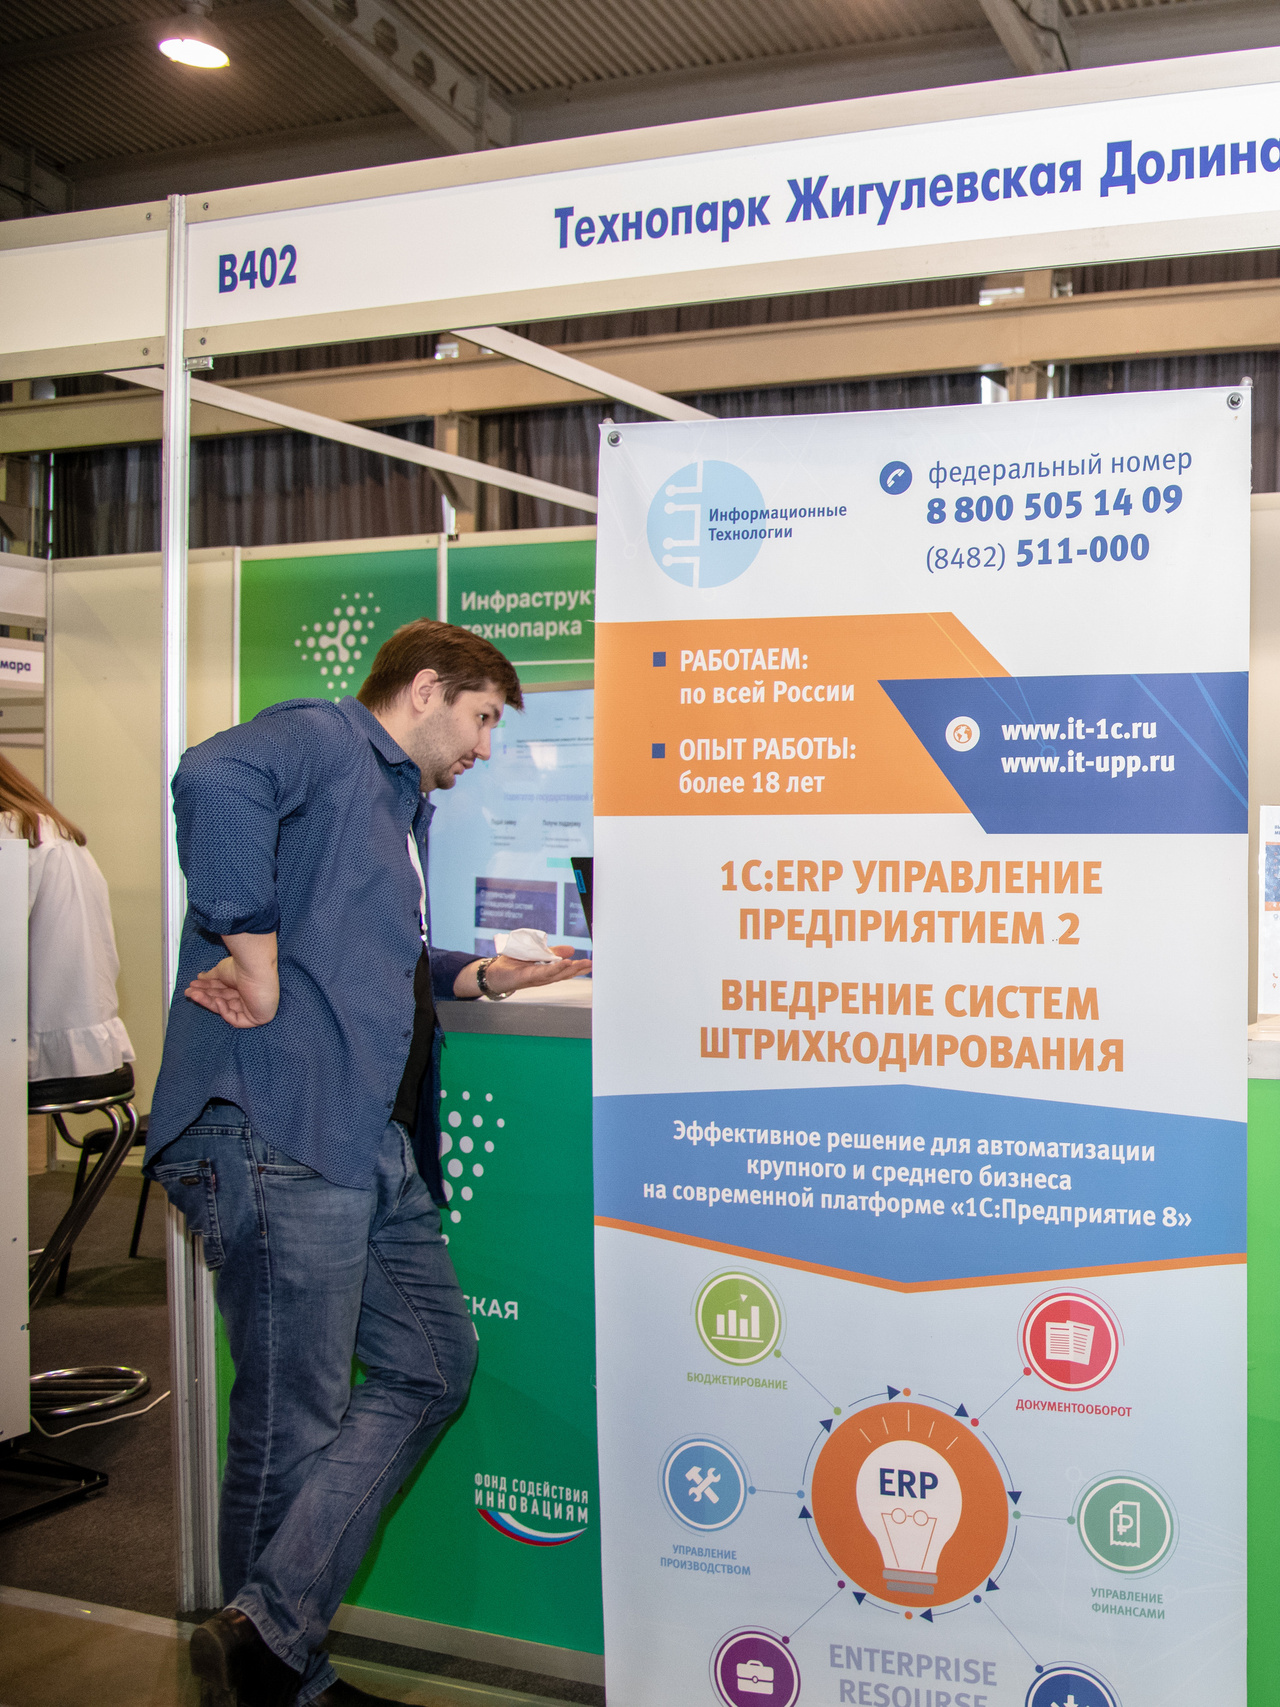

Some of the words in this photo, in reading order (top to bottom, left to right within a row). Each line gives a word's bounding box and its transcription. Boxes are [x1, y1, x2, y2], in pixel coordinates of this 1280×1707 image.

[555, 193, 770, 249] Технопарк
[786, 160, 1082, 225] Жигулевская
[928, 453, 1102, 487] федеральный
[1110, 452, 1193, 480] номер
[708, 503, 848, 525] Информационные
[927, 498, 947, 525] 8
[954, 496, 1014, 524] 800
[1024, 491, 1083, 521] 505
[1094, 488, 1133, 518] 14
[1142, 485, 1184, 515] 09
[708, 523, 793, 543] Технологии
[925, 542, 1007, 573] (8482)
[1016, 533, 1151, 568] 511-000
[461, 590, 595, 613] Инфраструк
[0, 660, 31, 673] мара
[680, 647, 809, 673] РАБОТАЕМ:
[680, 684, 707, 705] по
[713, 680, 766, 705] всей
[773, 679, 855, 704] России
[1001, 717, 1157, 742] www.it-1c.ru
[678, 737, 746, 763] ОПЫТ
[752, 736, 856, 762] РАБОТЫ:
[1001, 748, 1175, 778] www.it-upp.ru
[679, 770, 746, 794] более
[751, 771, 781, 794] 18
[785, 772, 825, 794] лет
[852, 860, 1103, 896] УПРАВЛЕНИЕ
[738, 908, 1045, 948] ПРЕДПРИЯТИЕМ
[1059, 912, 1081, 946] 2
[721, 978, 934, 1020] ВНЕДРЕНИЕ
[944, 984, 1100, 1021] СИСТЕМ
[699, 1026, 1125, 1073] ШТРИХКОДИРОВАНИЯ
[672, 1119, 821, 1148] Эффективное
[826, 1130, 927, 1156] решение
[930, 1134, 973, 1157] для
[976, 1137, 1156, 1165] автоматизации
[746, 1157, 847, 1181] крупного
[852, 1162, 867, 1181] и
[871, 1165, 974, 1190] среднего
[979, 1165, 1073, 1192] бизнеса
[642, 1182, 668, 1201] на
[672, 1179, 815, 1209] современной
[820, 1188, 946, 1218] платформе
[950, 1196, 1157, 1227] «1С:Предприятие
[1162, 1204, 1193, 1229] 8»
[686, 1371, 788, 1391] БЮДЖЕТИРОВАНИЕ
[1015, 1398, 1132, 1418] ДОКУМЕНТООБОРОТ
[474, 1473, 507, 1492] ФОНД
[512, 1478, 589, 1503] СОДЕЙСТВИЯ
[878, 1467, 939, 1501] ERP
[474, 1489, 589, 1524] ИННОВАЦИЯМ
[660, 1556, 752, 1577] ПРОИЗВОДСТВОМ
[671, 1543, 738, 1561] УПРАВЛЕНИЕ
[1091, 1586, 1163, 1605] УПРАВЛЕНИЕ
[1091, 1601, 1166, 1620] ФИНАНСАМИ
[829, 1643, 997, 1688] ENTERPRISE
